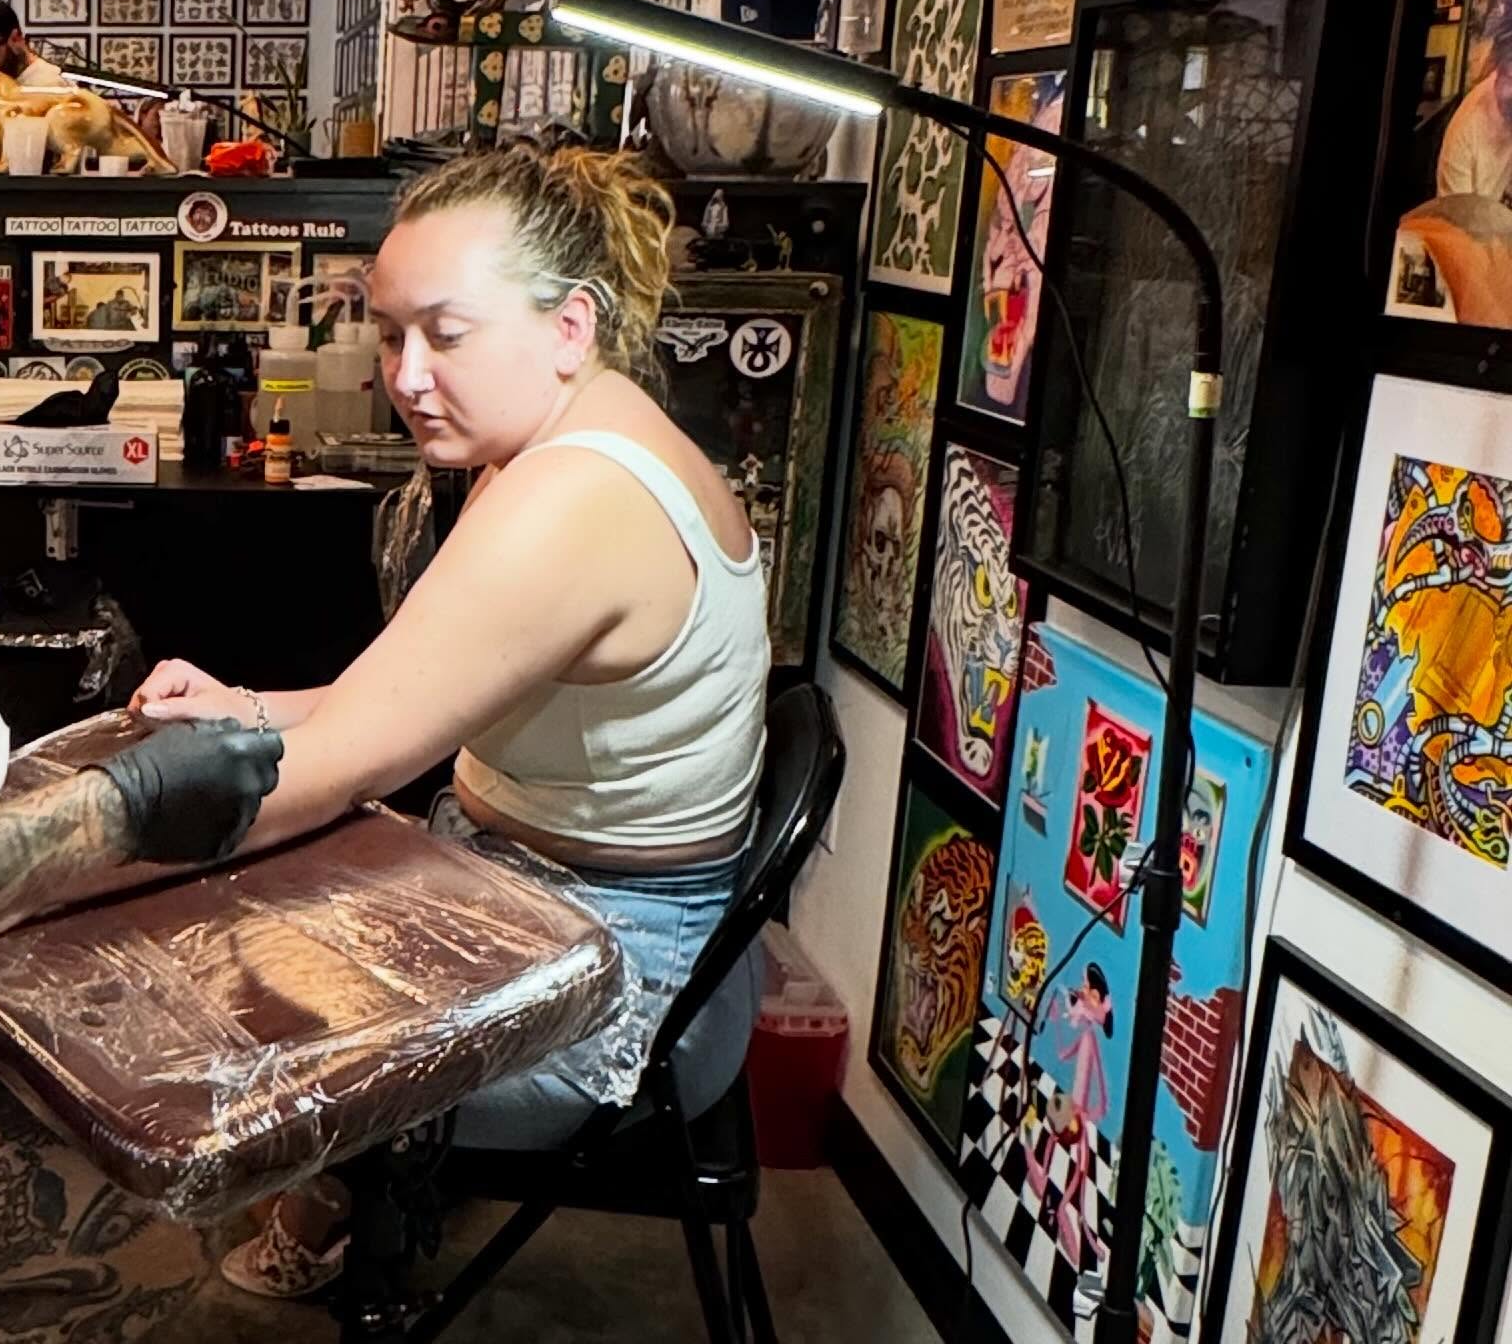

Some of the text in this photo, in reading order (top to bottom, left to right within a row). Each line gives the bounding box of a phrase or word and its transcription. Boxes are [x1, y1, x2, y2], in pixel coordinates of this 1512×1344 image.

[10, 220, 176, 233] TATTOO TATTOO TATTOO
[230, 221, 346, 238] Tattoos Rule
[32, 442, 105, 458] SuperSource
[126, 441, 147, 459] XL
